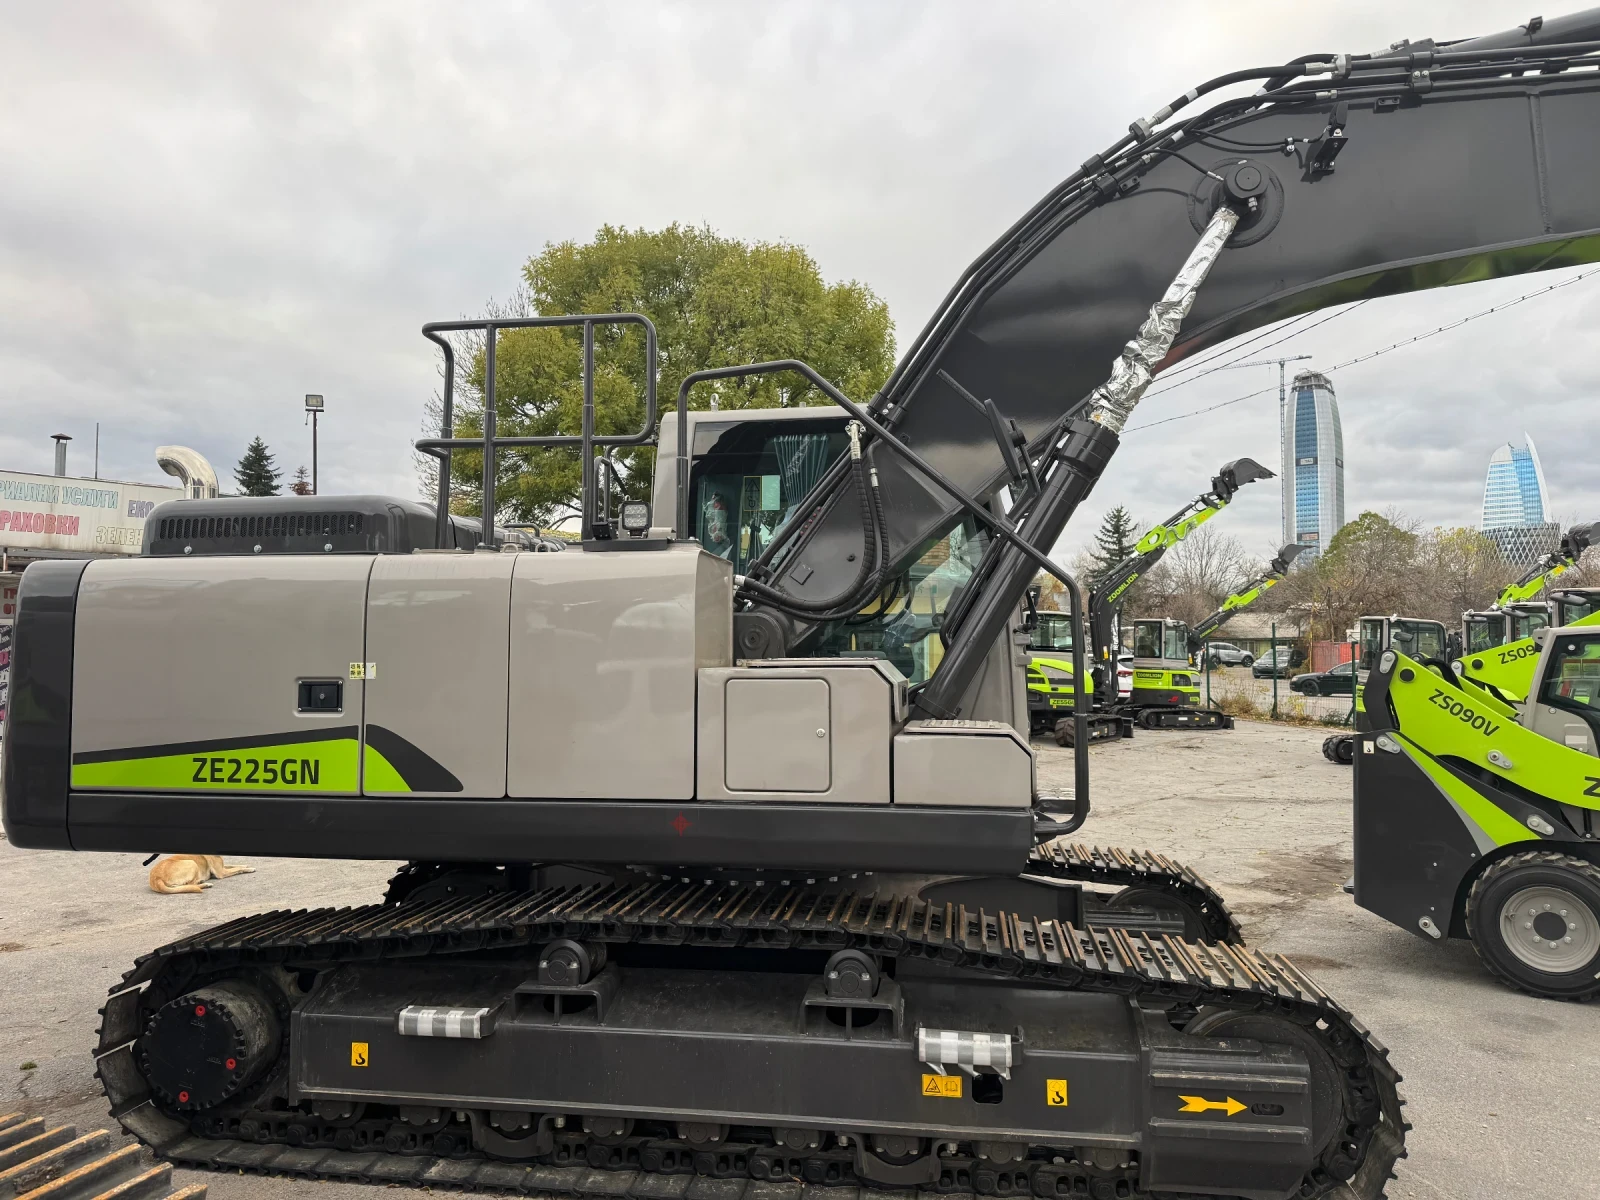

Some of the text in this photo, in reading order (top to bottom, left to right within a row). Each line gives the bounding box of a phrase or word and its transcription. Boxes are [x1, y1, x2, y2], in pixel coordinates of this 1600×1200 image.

[62, 486, 119, 509] УСЛУГИ
[0, 509, 80, 536] РАХОВКИ
[1106, 572, 1139, 603] ZOOMLION
[1428, 688, 1501, 738] ZS090V
[192, 757, 320, 785] ZE225GN
